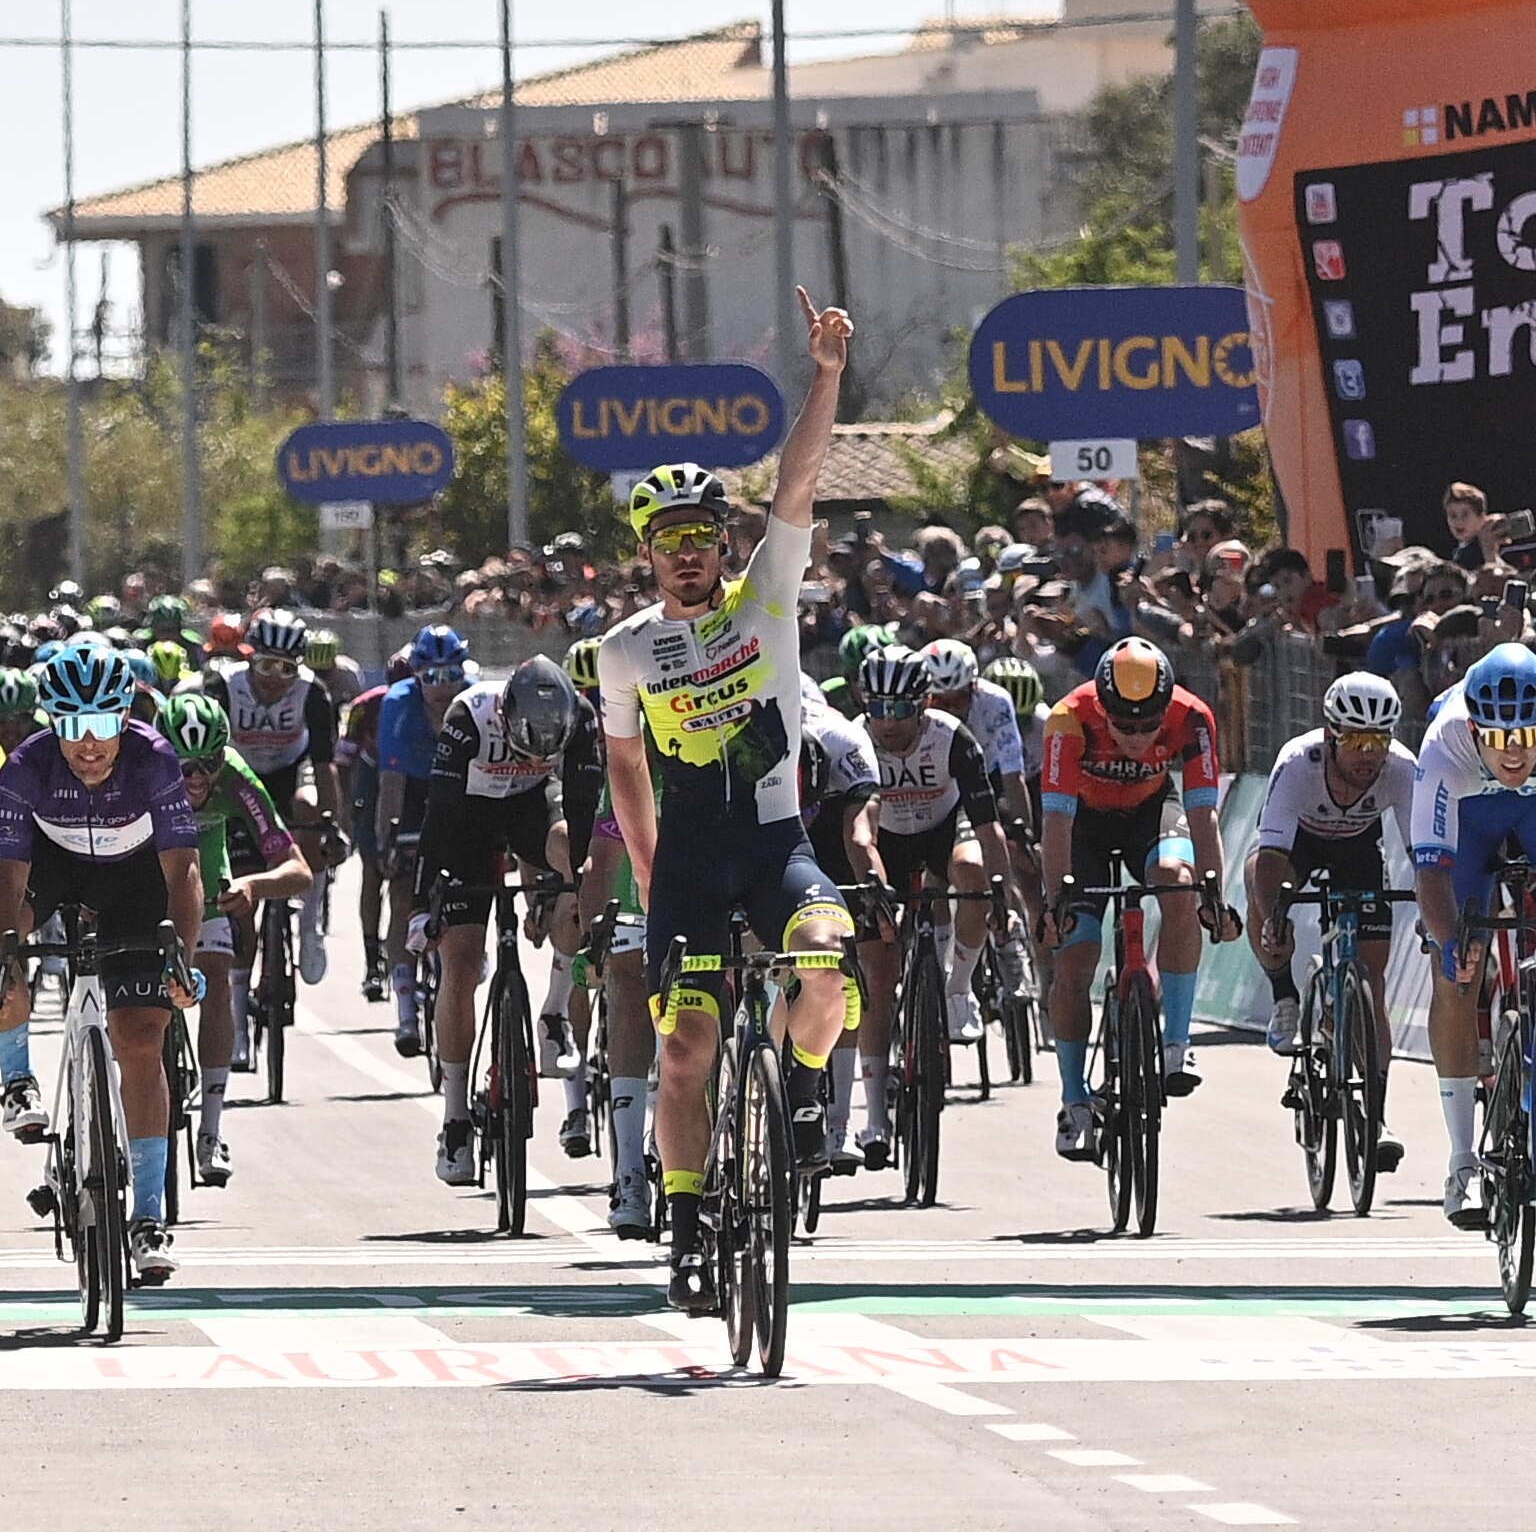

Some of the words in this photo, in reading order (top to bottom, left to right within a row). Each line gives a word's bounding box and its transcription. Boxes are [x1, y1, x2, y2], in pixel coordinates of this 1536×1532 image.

[992, 330, 1257, 394] LIVIGNO
[571, 394, 770, 439] LIVIGNO
[288, 442, 444, 484] LIVIGNO
[1075, 446, 1112, 472] 50
[238, 708, 295, 732] UAE
[1433, 779, 1451, 839] GIANT
